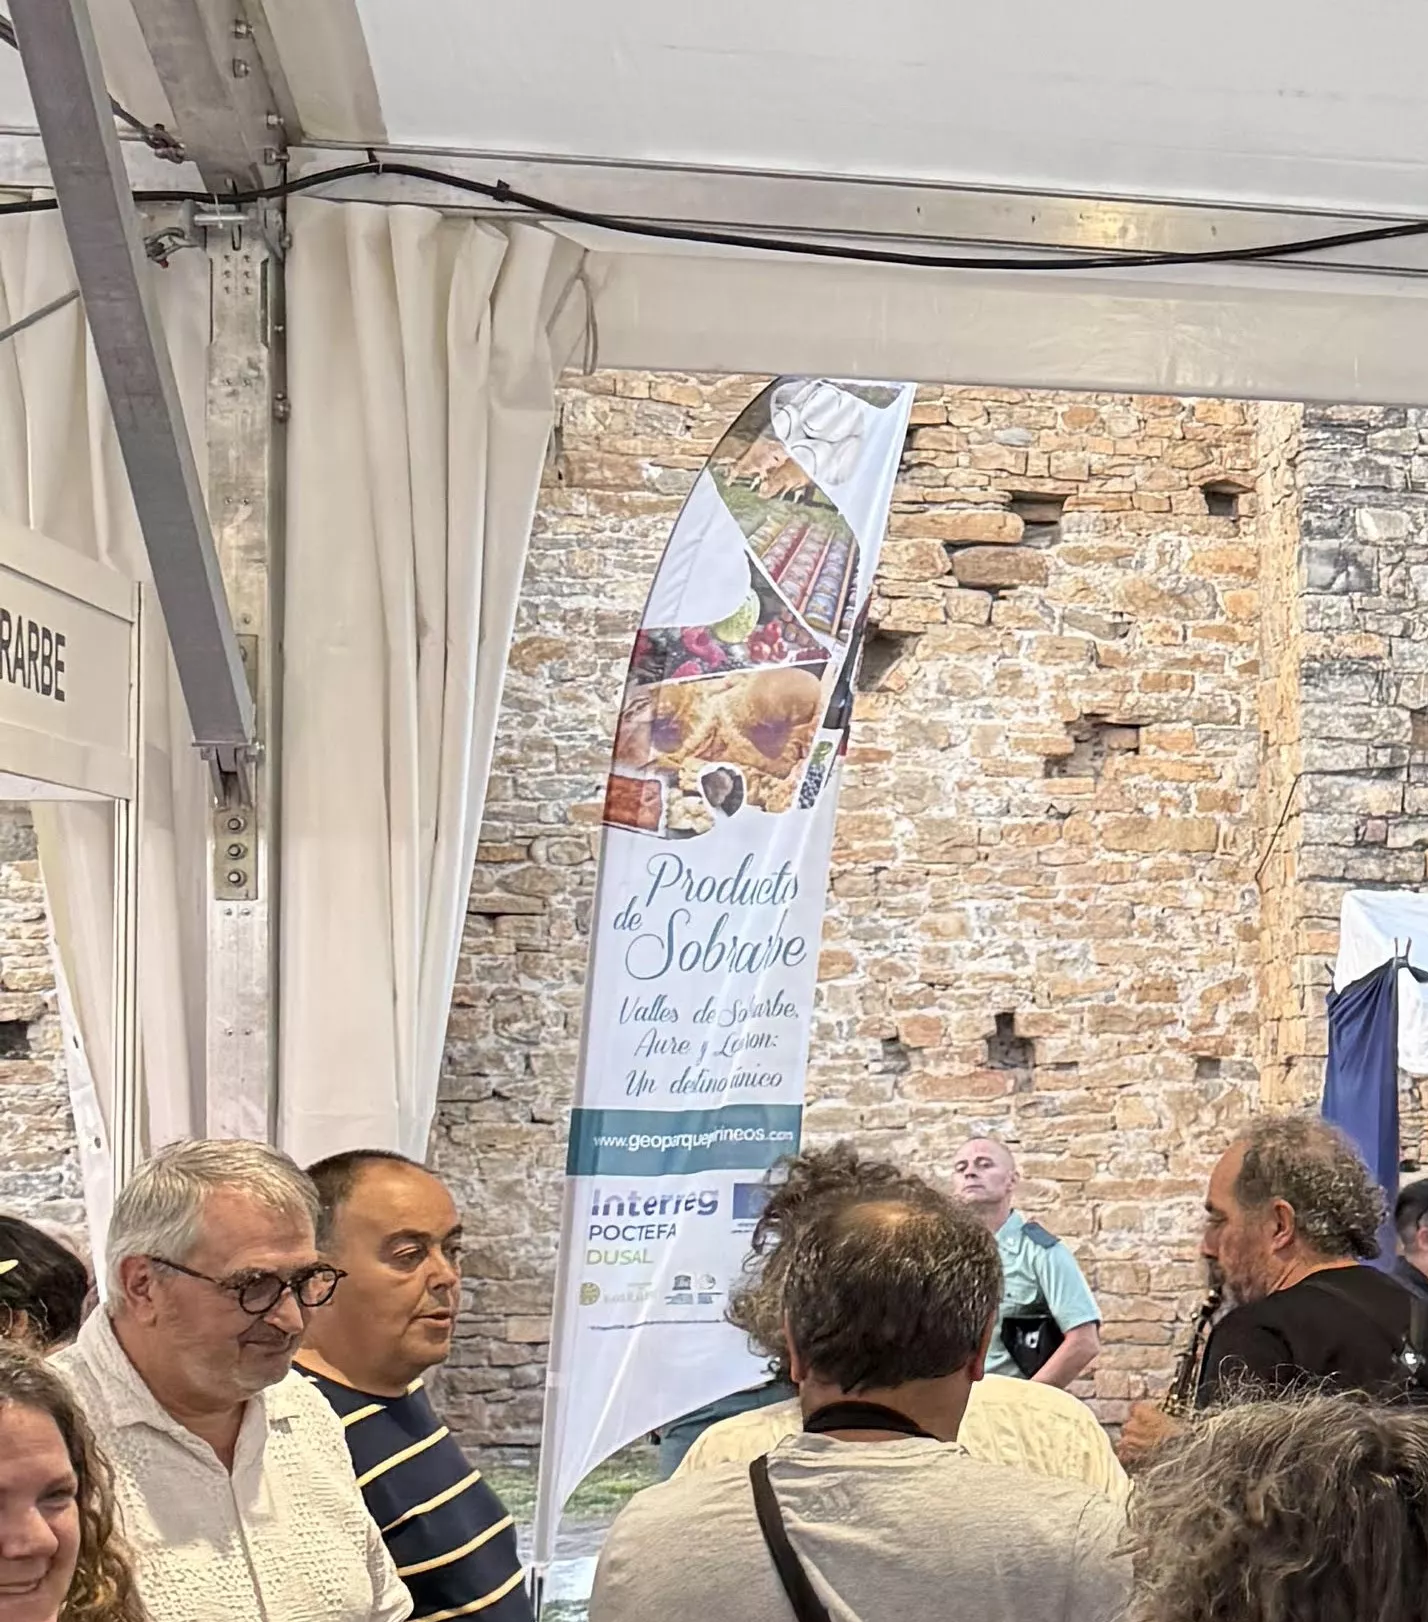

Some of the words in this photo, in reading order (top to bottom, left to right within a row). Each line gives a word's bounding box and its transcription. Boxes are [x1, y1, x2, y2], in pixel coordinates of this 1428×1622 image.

[613, 896, 643, 931] de
[619, 994, 679, 1025] Valles
[693, 995, 716, 1023] de
[633, 1028, 691, 1058] Aure
[625, 1069, 657, 1097] Un
[591, 1188, 719, 1217] Interreg
[588, 1223, 677, 1242] POCTEFA
[586, 1249, 655, 1266] DUSAL
